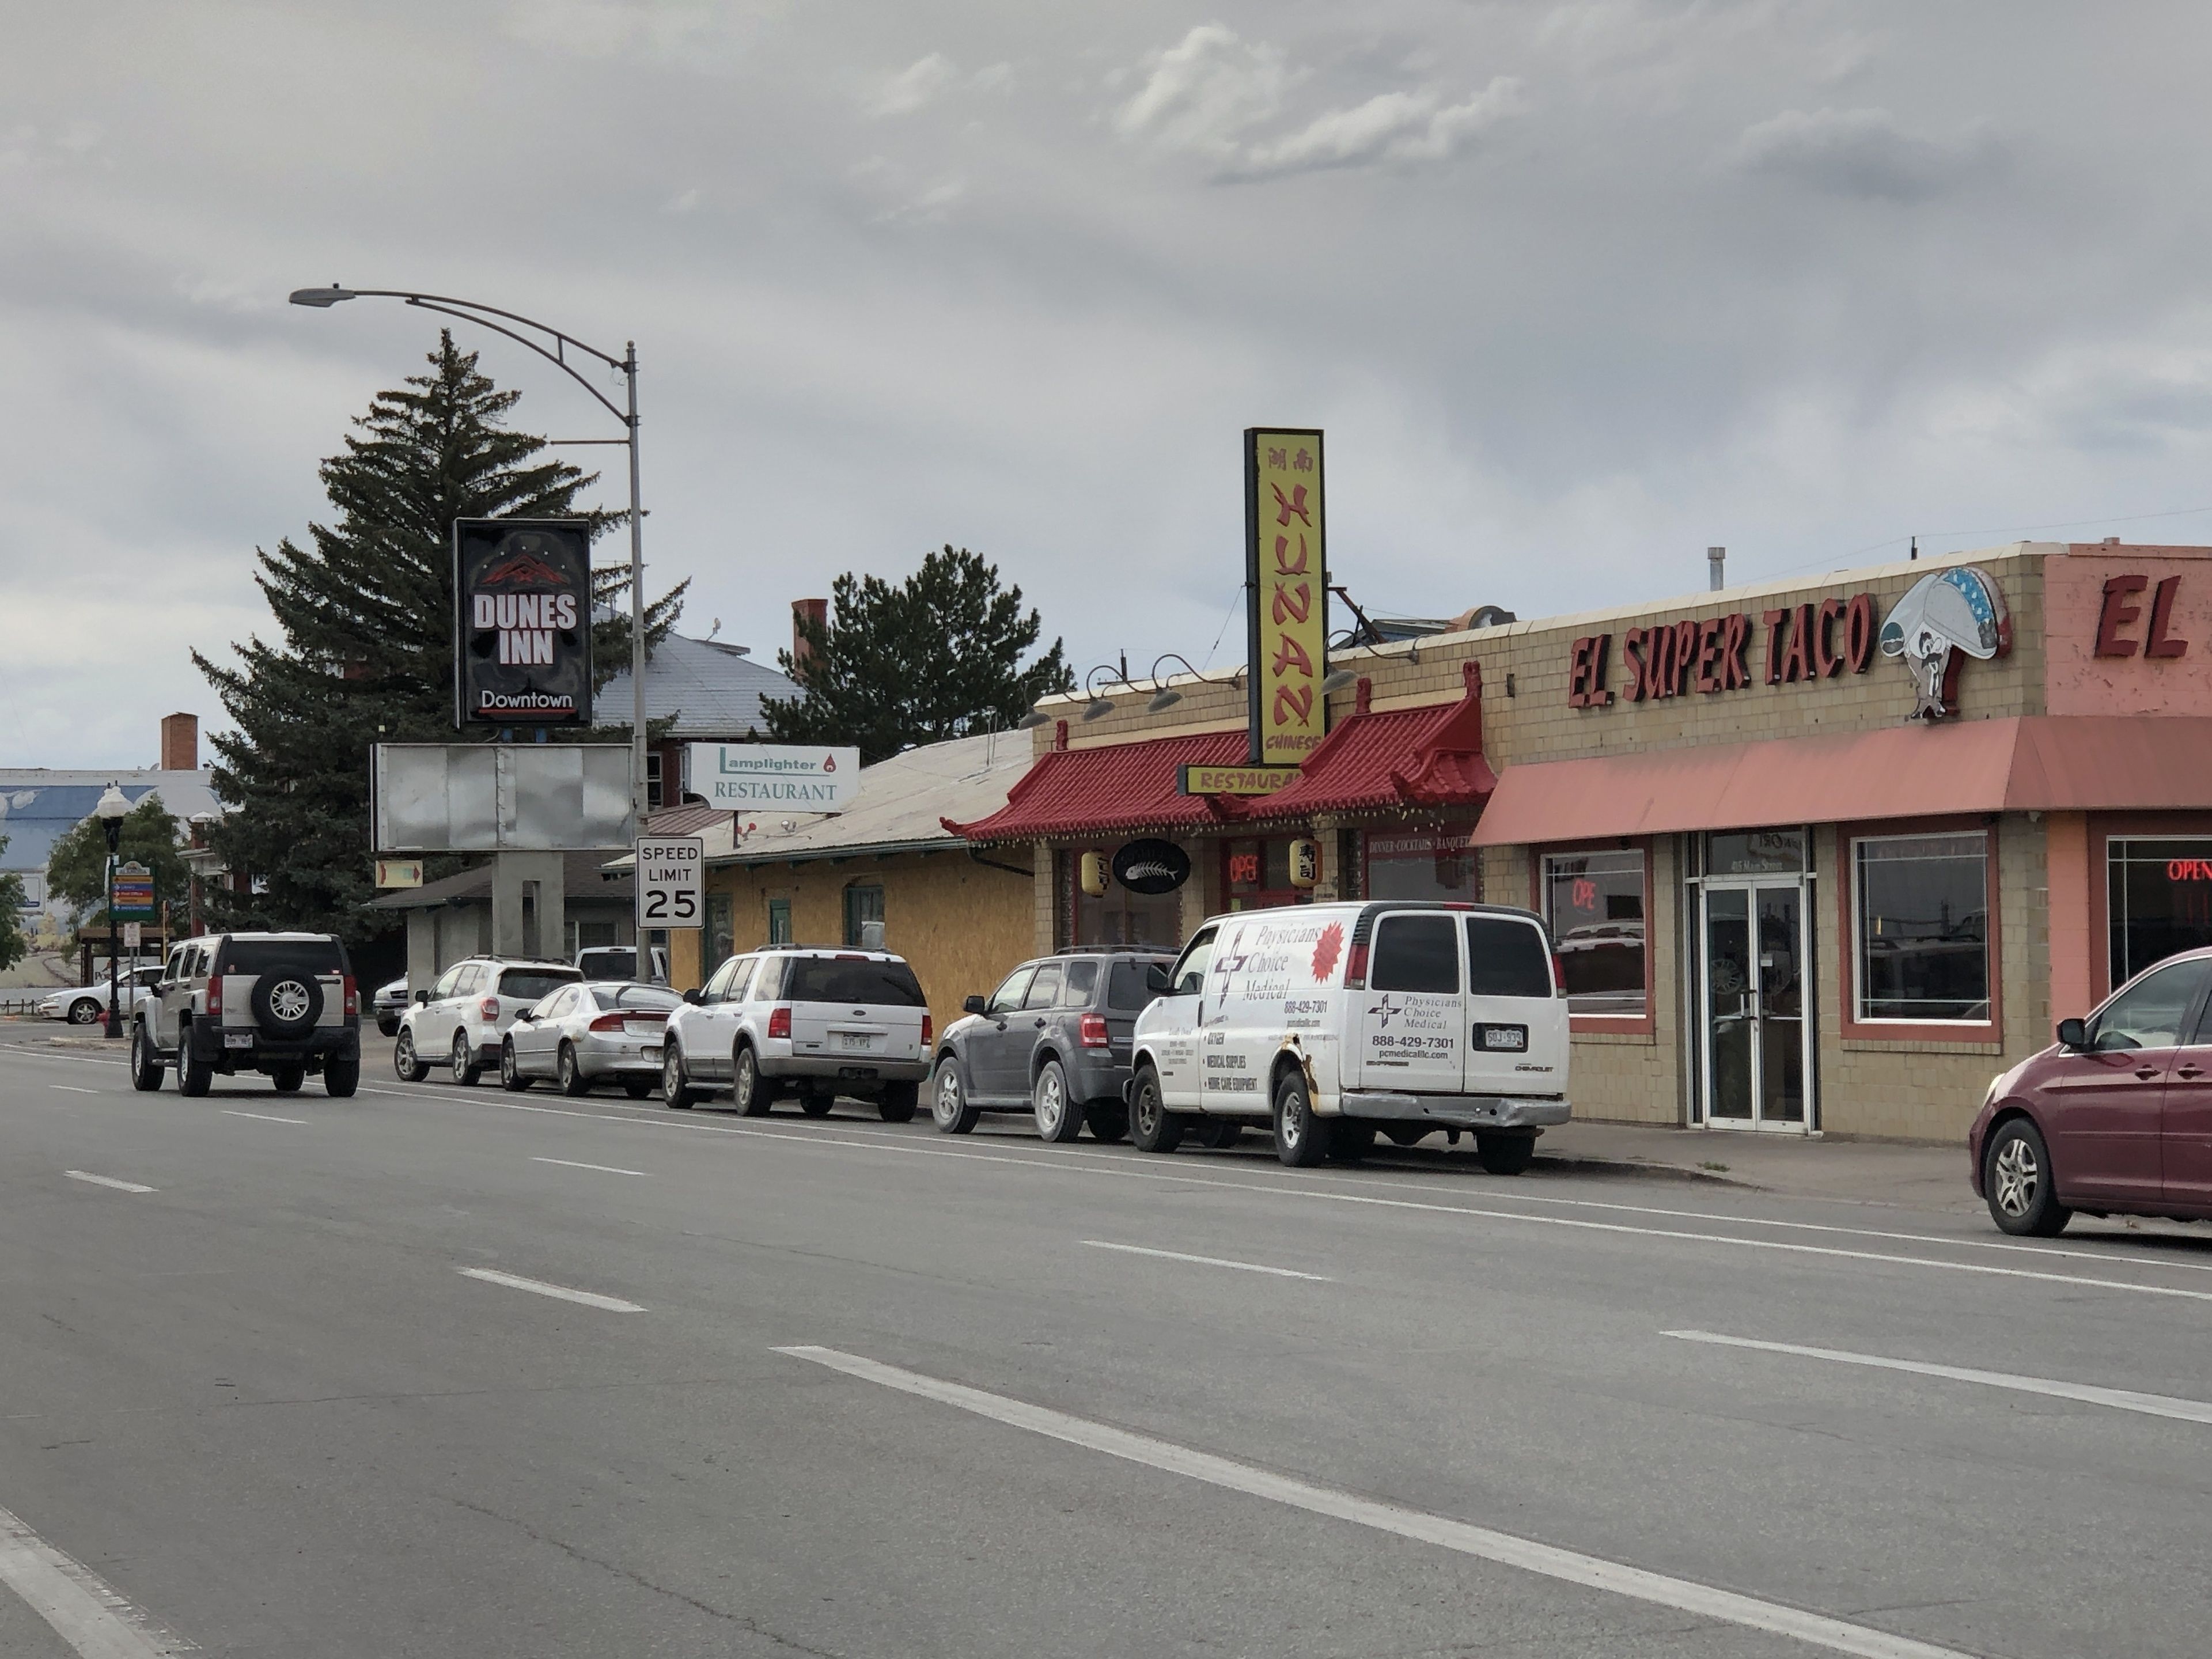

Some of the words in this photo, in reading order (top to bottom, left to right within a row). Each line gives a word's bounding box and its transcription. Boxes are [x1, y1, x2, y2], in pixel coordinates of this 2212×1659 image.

[474, 594, 577, 629] DUNES
[1271, 482, 1313, 728] HUNAN
[2094, 574, 2188, 658] EL
[499, 630, 554, 665] INN
[1568, 634, 1614, 709] EL
[1623, 613, 1752, 702] SUPER
[1763, 591, 1878, 685] TACO
[482, 691, 573, 708] Downtown
[1266, 734, 1321, 749] CHINESE
[720, 747, 816, 774] Lamplighter
[714, 781, 837, 800] RESTAURANT
[642, 847, 698, 860] SPEED
[649, 869, 691, 881] LIMIT
[646, 890, 696, 918] 25
[1255, 923, 1321, 949] Physicians
[1248, 952, 1289, 973] Choice
[1243, 978, 1290, 1001] Medical
[1284, 1000, 1328, 1014] 888-429-7301
[1404, 995, 1462, 1007] Physicians
[1404, 1008, 1441, 1018] Choice
[1404, 1018, 1447, 1029] Medical
[1372, 1036, 1454, 1049] 888-429-7301
